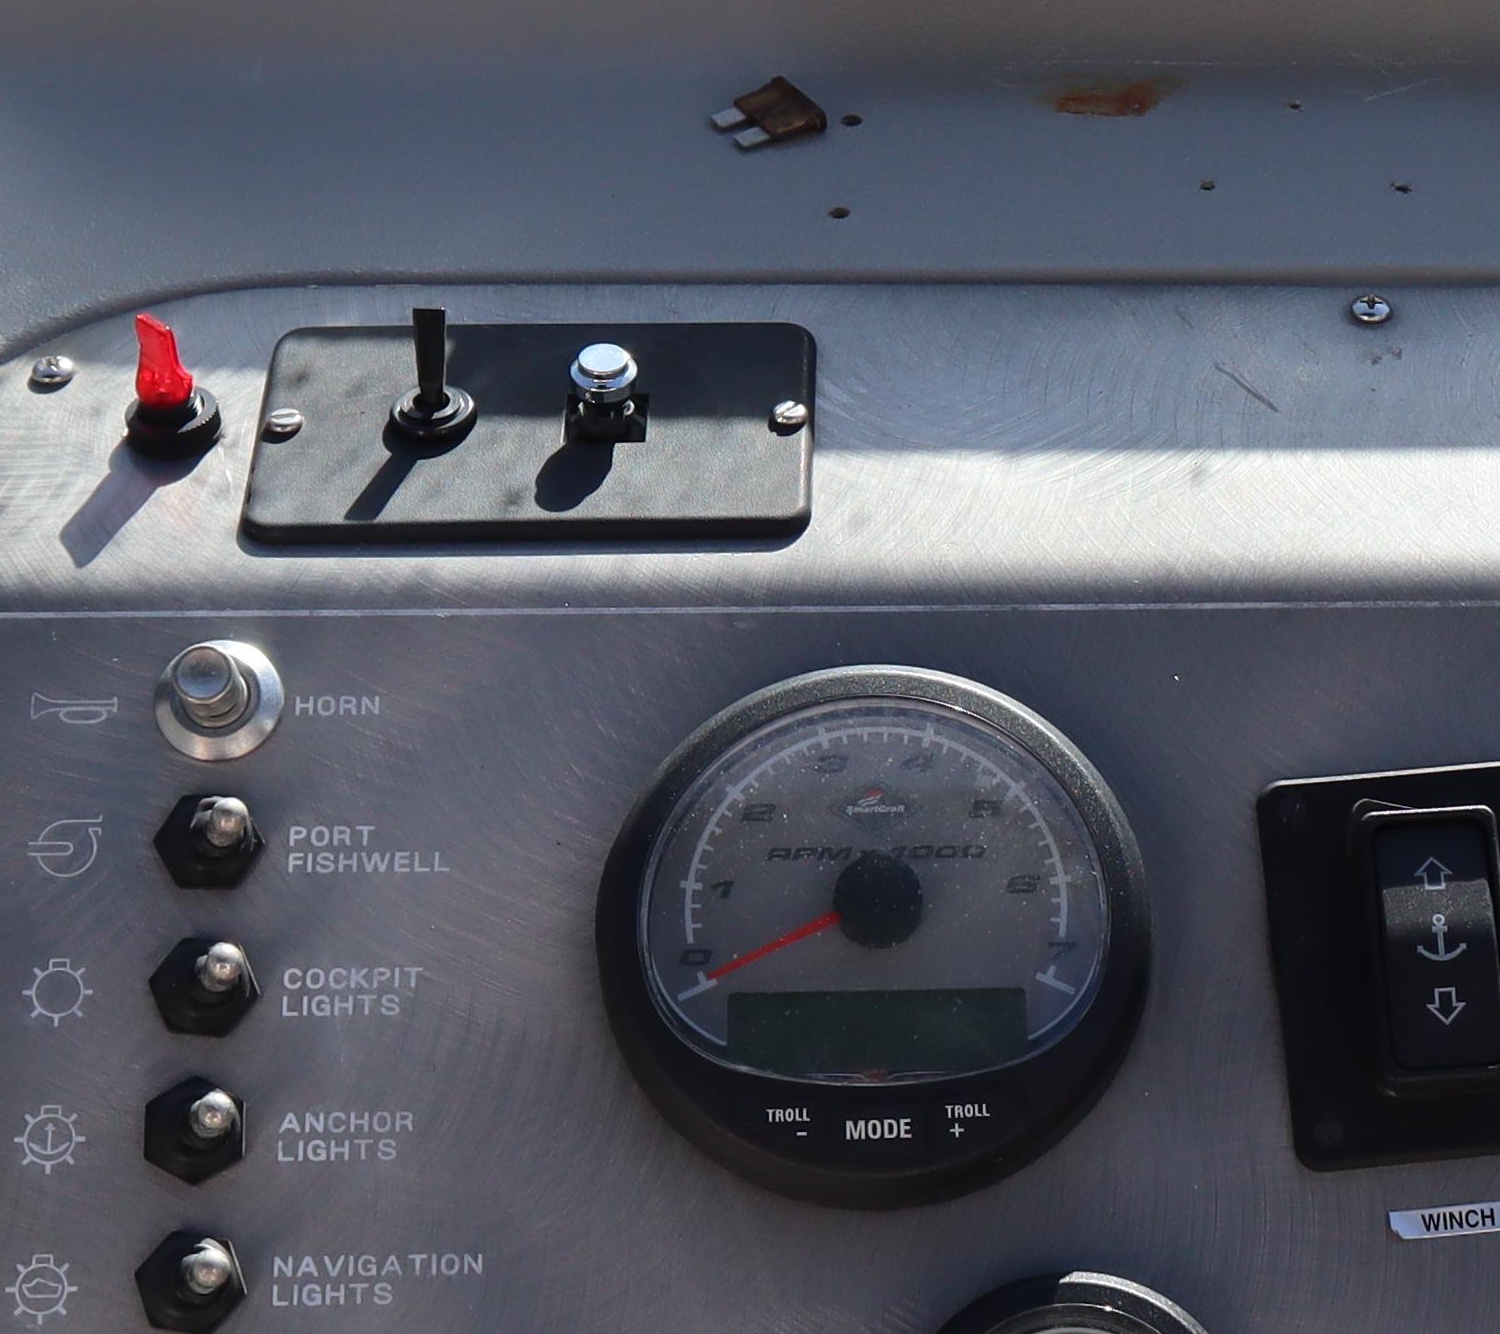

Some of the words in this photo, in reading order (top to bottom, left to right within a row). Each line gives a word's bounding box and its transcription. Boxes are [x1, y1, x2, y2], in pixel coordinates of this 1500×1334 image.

[294, 695, 381, 716] HORN
[288, 825, 376, 847] PORT
[287, 851, 450, 874] FISHWELL
[767, 846, 852, 862] RPM
[678, 947, 714, 967] 0
[282, 968, 424, 990] COCKPIT
[281, 994, 401, 1017] LIGHTS
[279, 1110, 415, 1134] ANCHOR
[766, 1108, 810, 1123] TROLL
[945, 1103, 990, 1119] TROLL
[845, 1117, 913, 1141] MODE
[277, 1137, 398, 1162] LIGHTS
[1421, 1207, 1497, 1232] WINCH
[273, 1252, 484, 1280] NAVIGATION
[272, 1282, 395, 1307] LIGHTS
